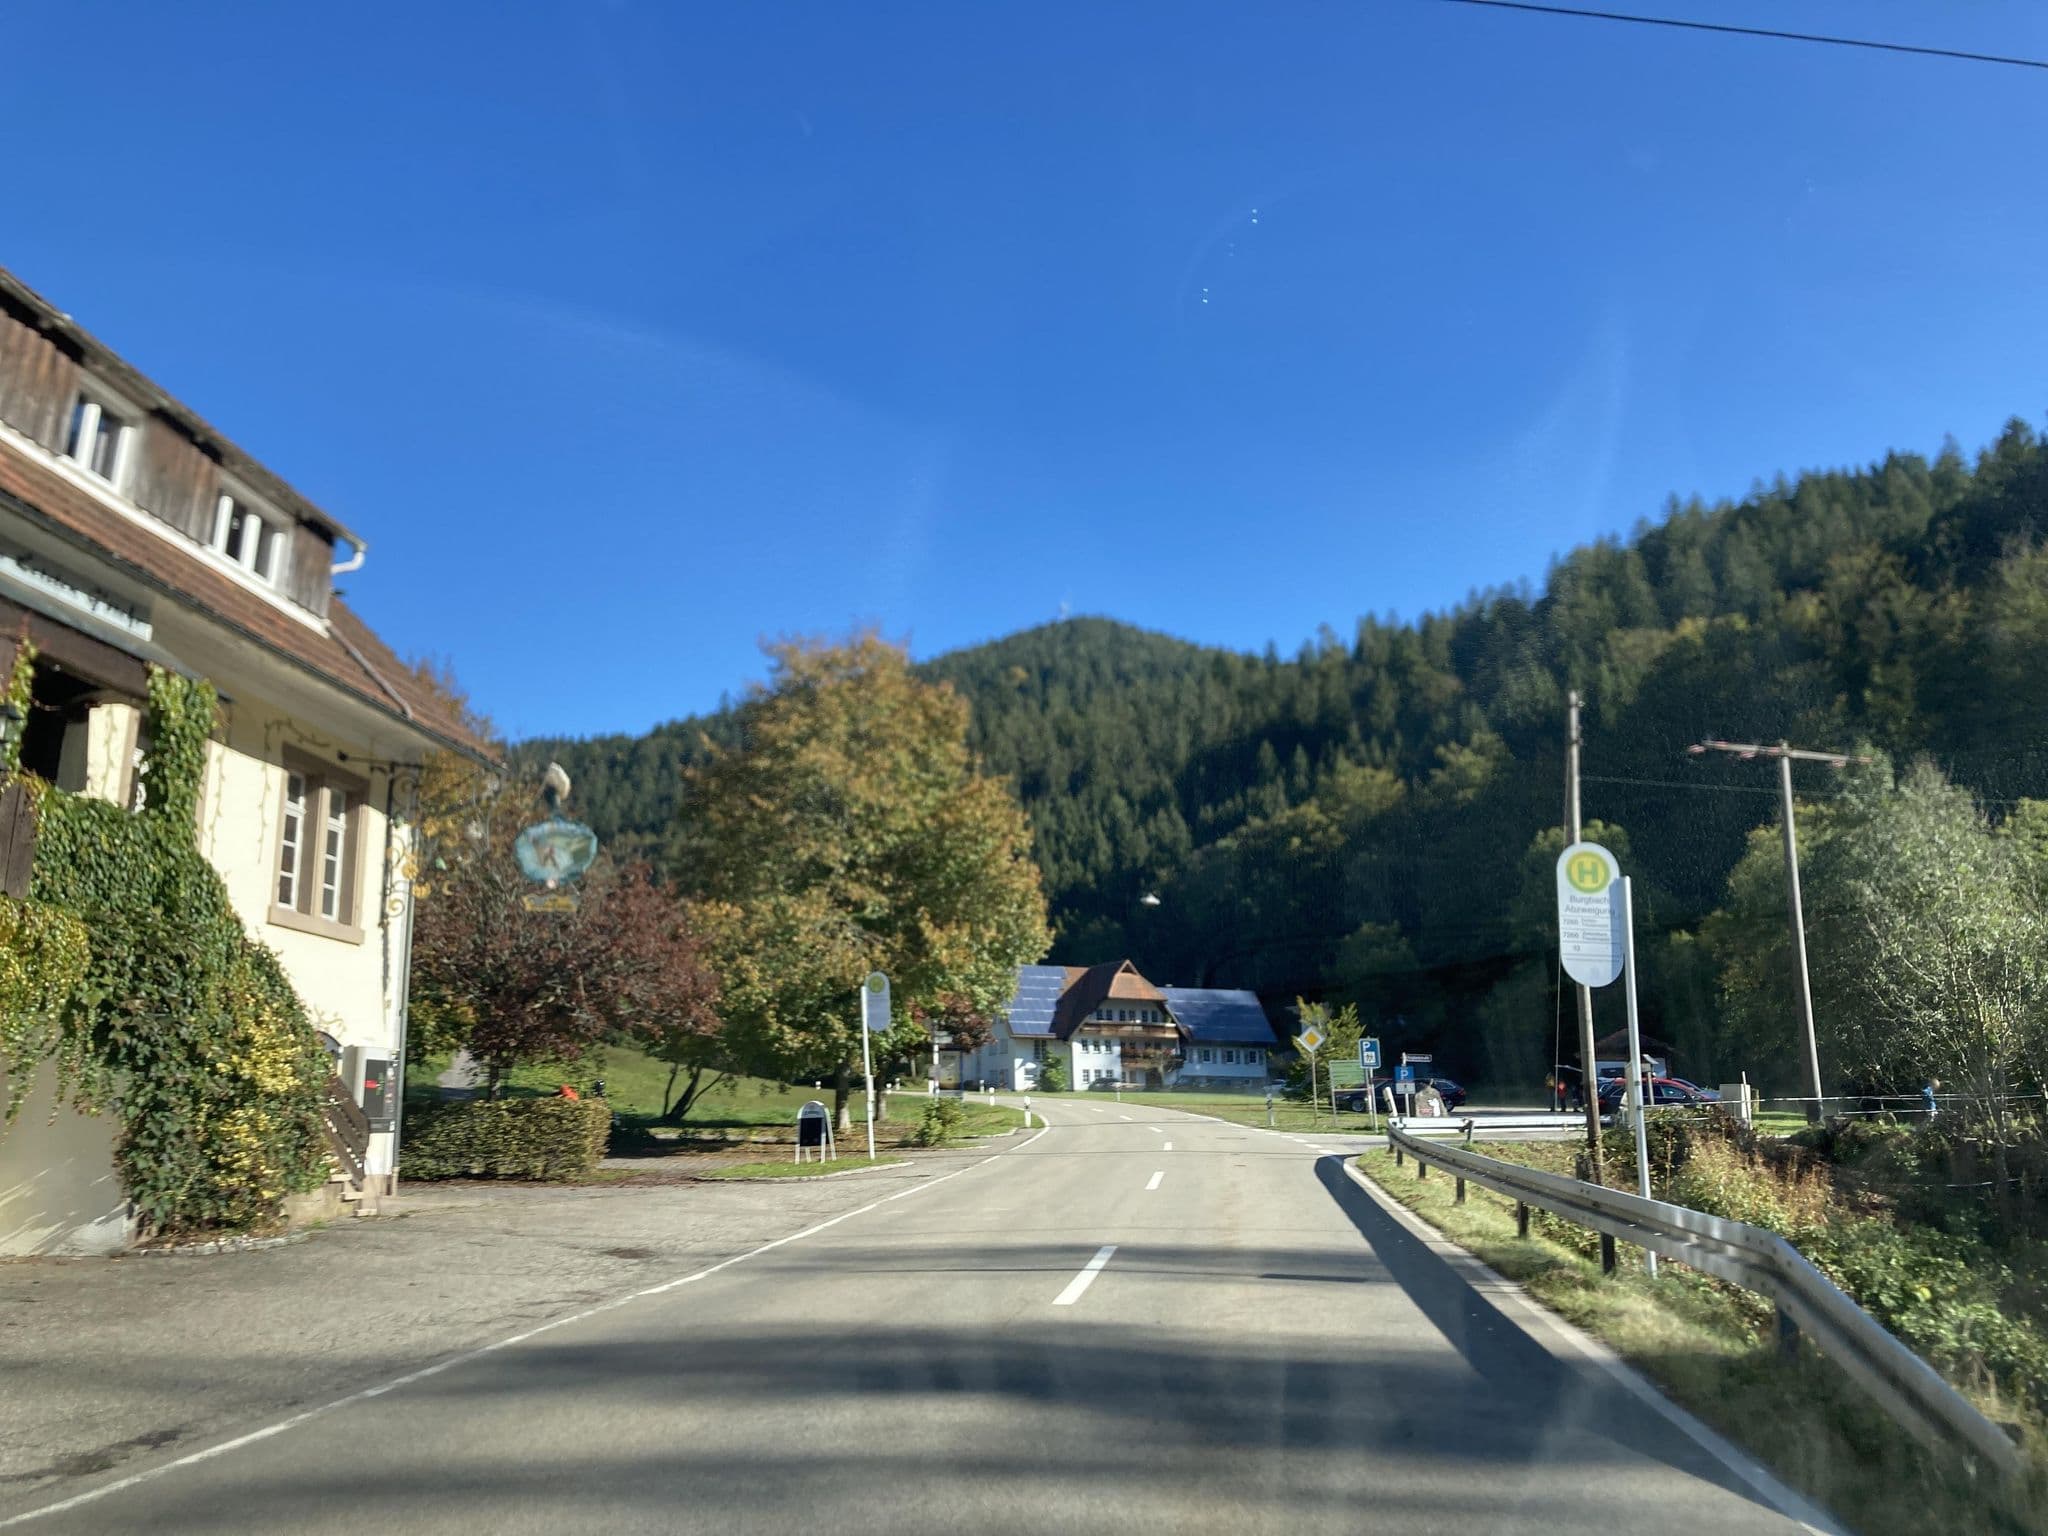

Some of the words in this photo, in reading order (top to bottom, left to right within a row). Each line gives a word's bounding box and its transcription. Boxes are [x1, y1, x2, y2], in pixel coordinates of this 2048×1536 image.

[1578, 861, 1599, 883] H
[1362, 1041, 1371, 1051] P
[1400, 1069, 1409, 1080] P
